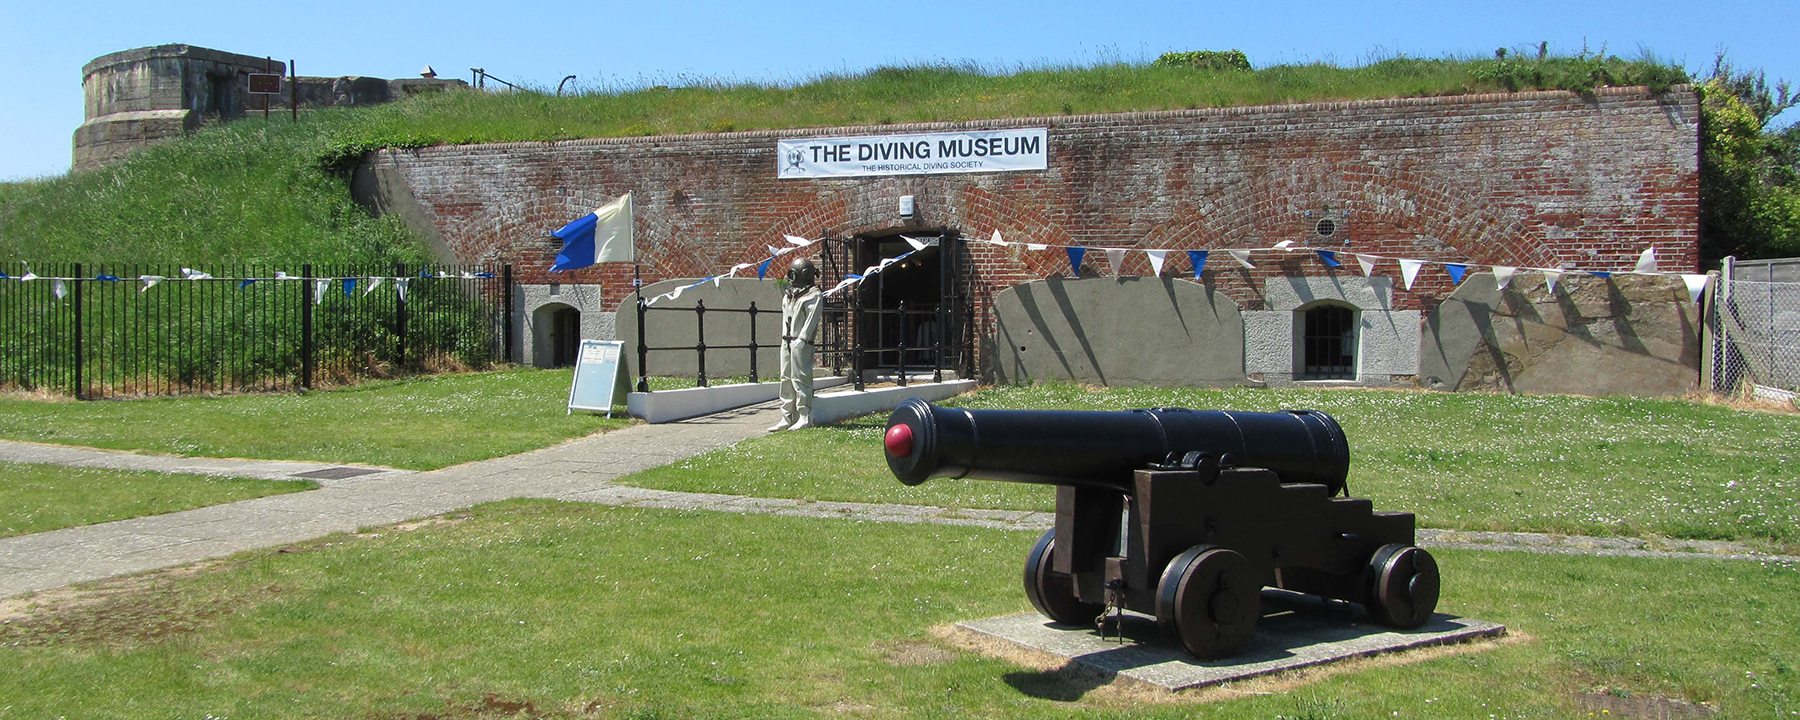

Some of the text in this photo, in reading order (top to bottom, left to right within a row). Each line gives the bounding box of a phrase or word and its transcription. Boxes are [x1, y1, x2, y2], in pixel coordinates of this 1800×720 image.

[810, 136, 1040, 163] THE DIVING MUSEUM
[877, 163, 921, 171] HISTORICAL
[923, 162, 949, 170] DIVING
[950, 160, 983, 169] SOCIETY
